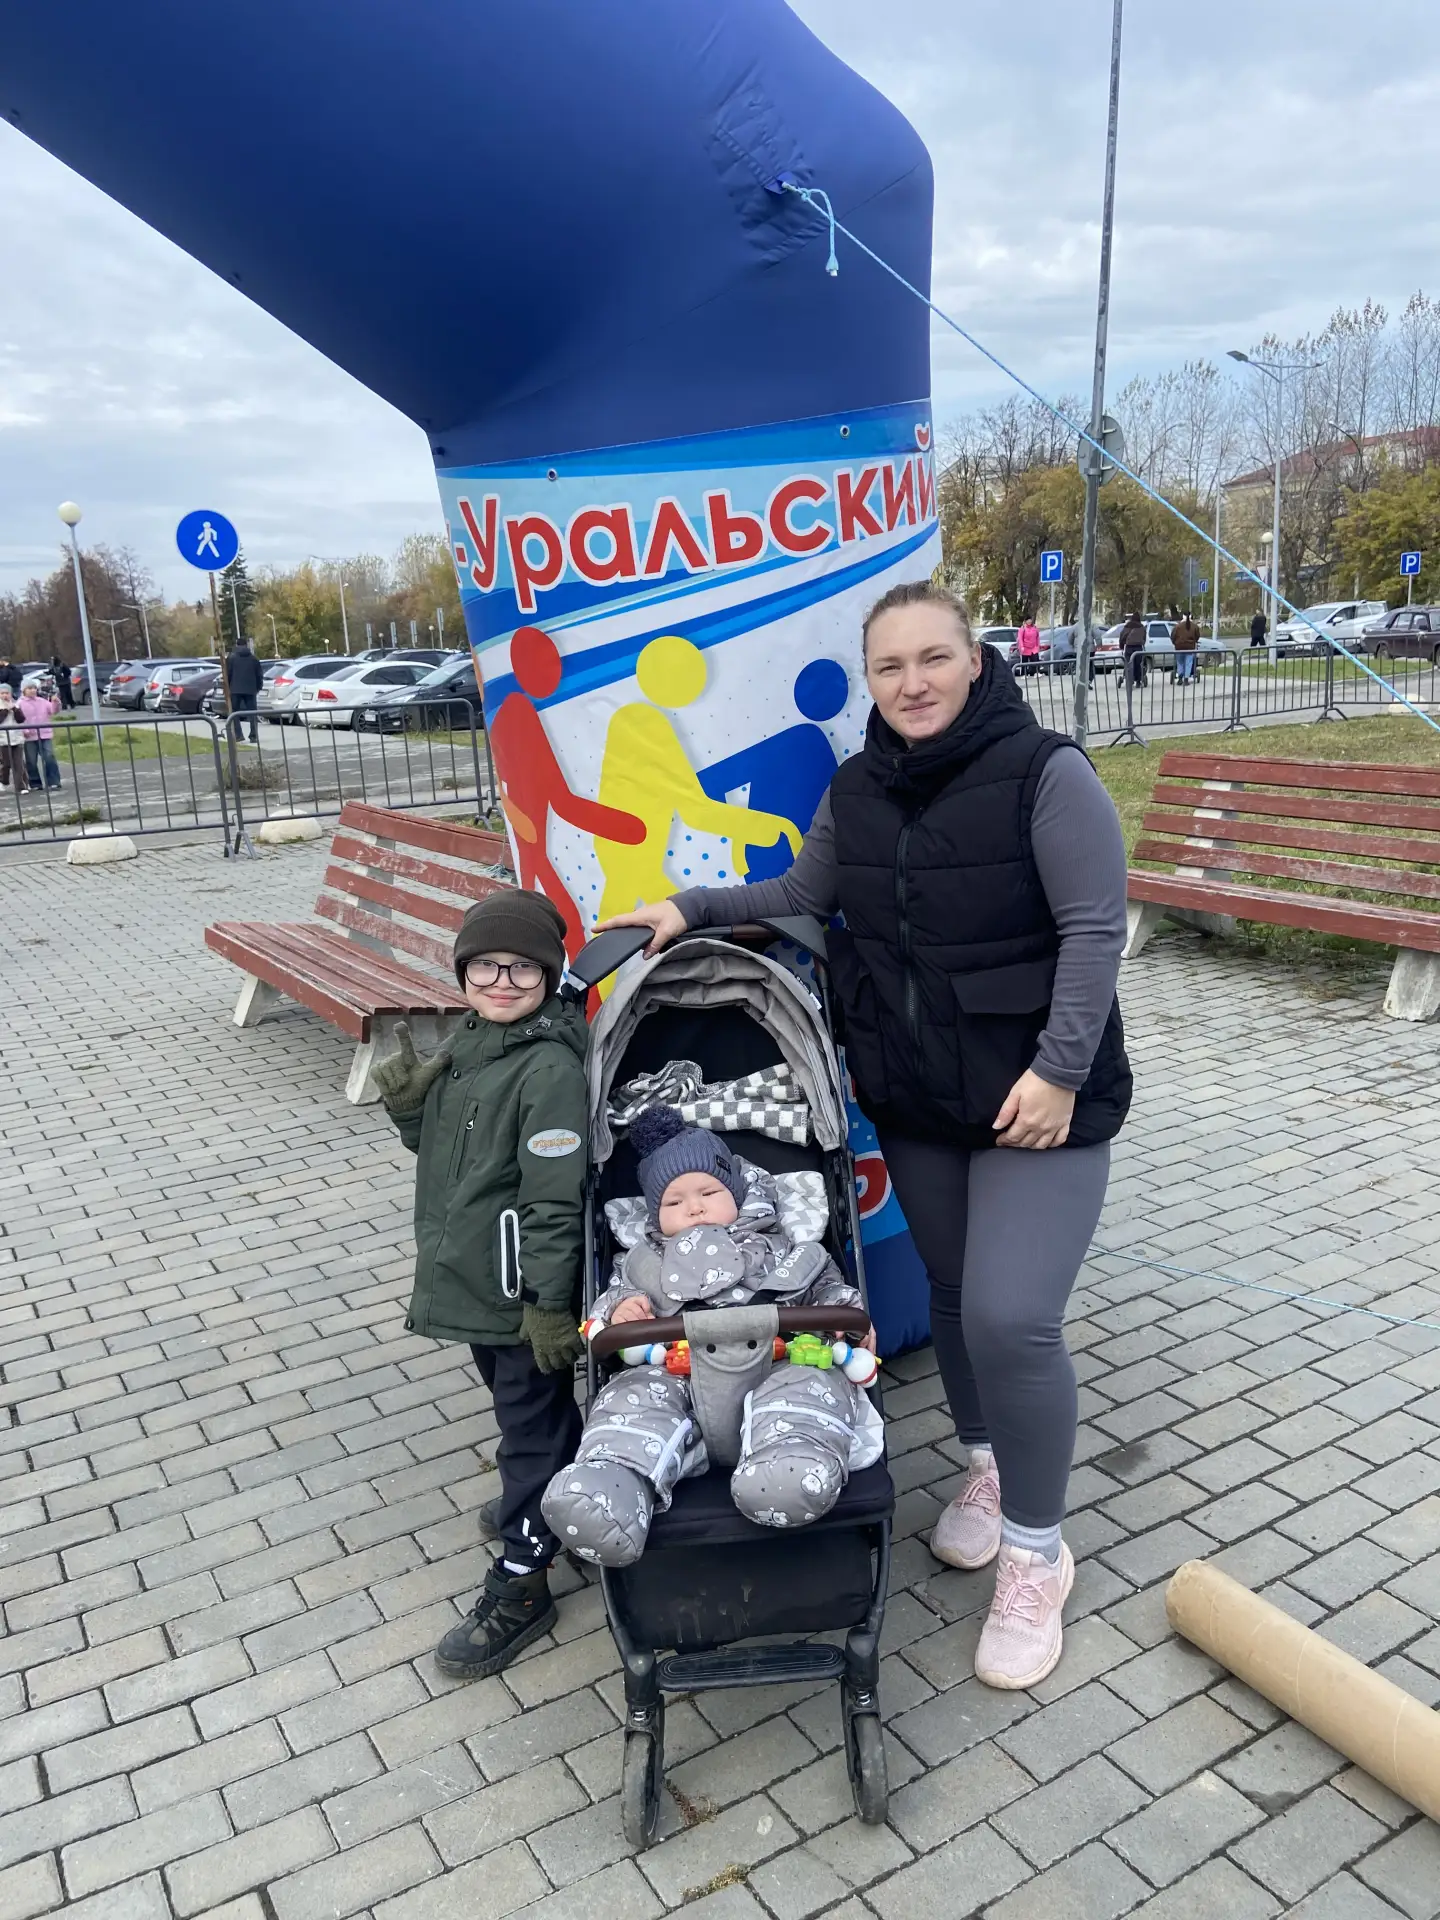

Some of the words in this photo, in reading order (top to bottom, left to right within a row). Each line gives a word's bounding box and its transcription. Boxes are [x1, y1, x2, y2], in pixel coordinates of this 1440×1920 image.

[447, 423, 938, 613] -Уральский
[1046, 554, 1059, 579] P
[1405, 554, 1417, 573] P
